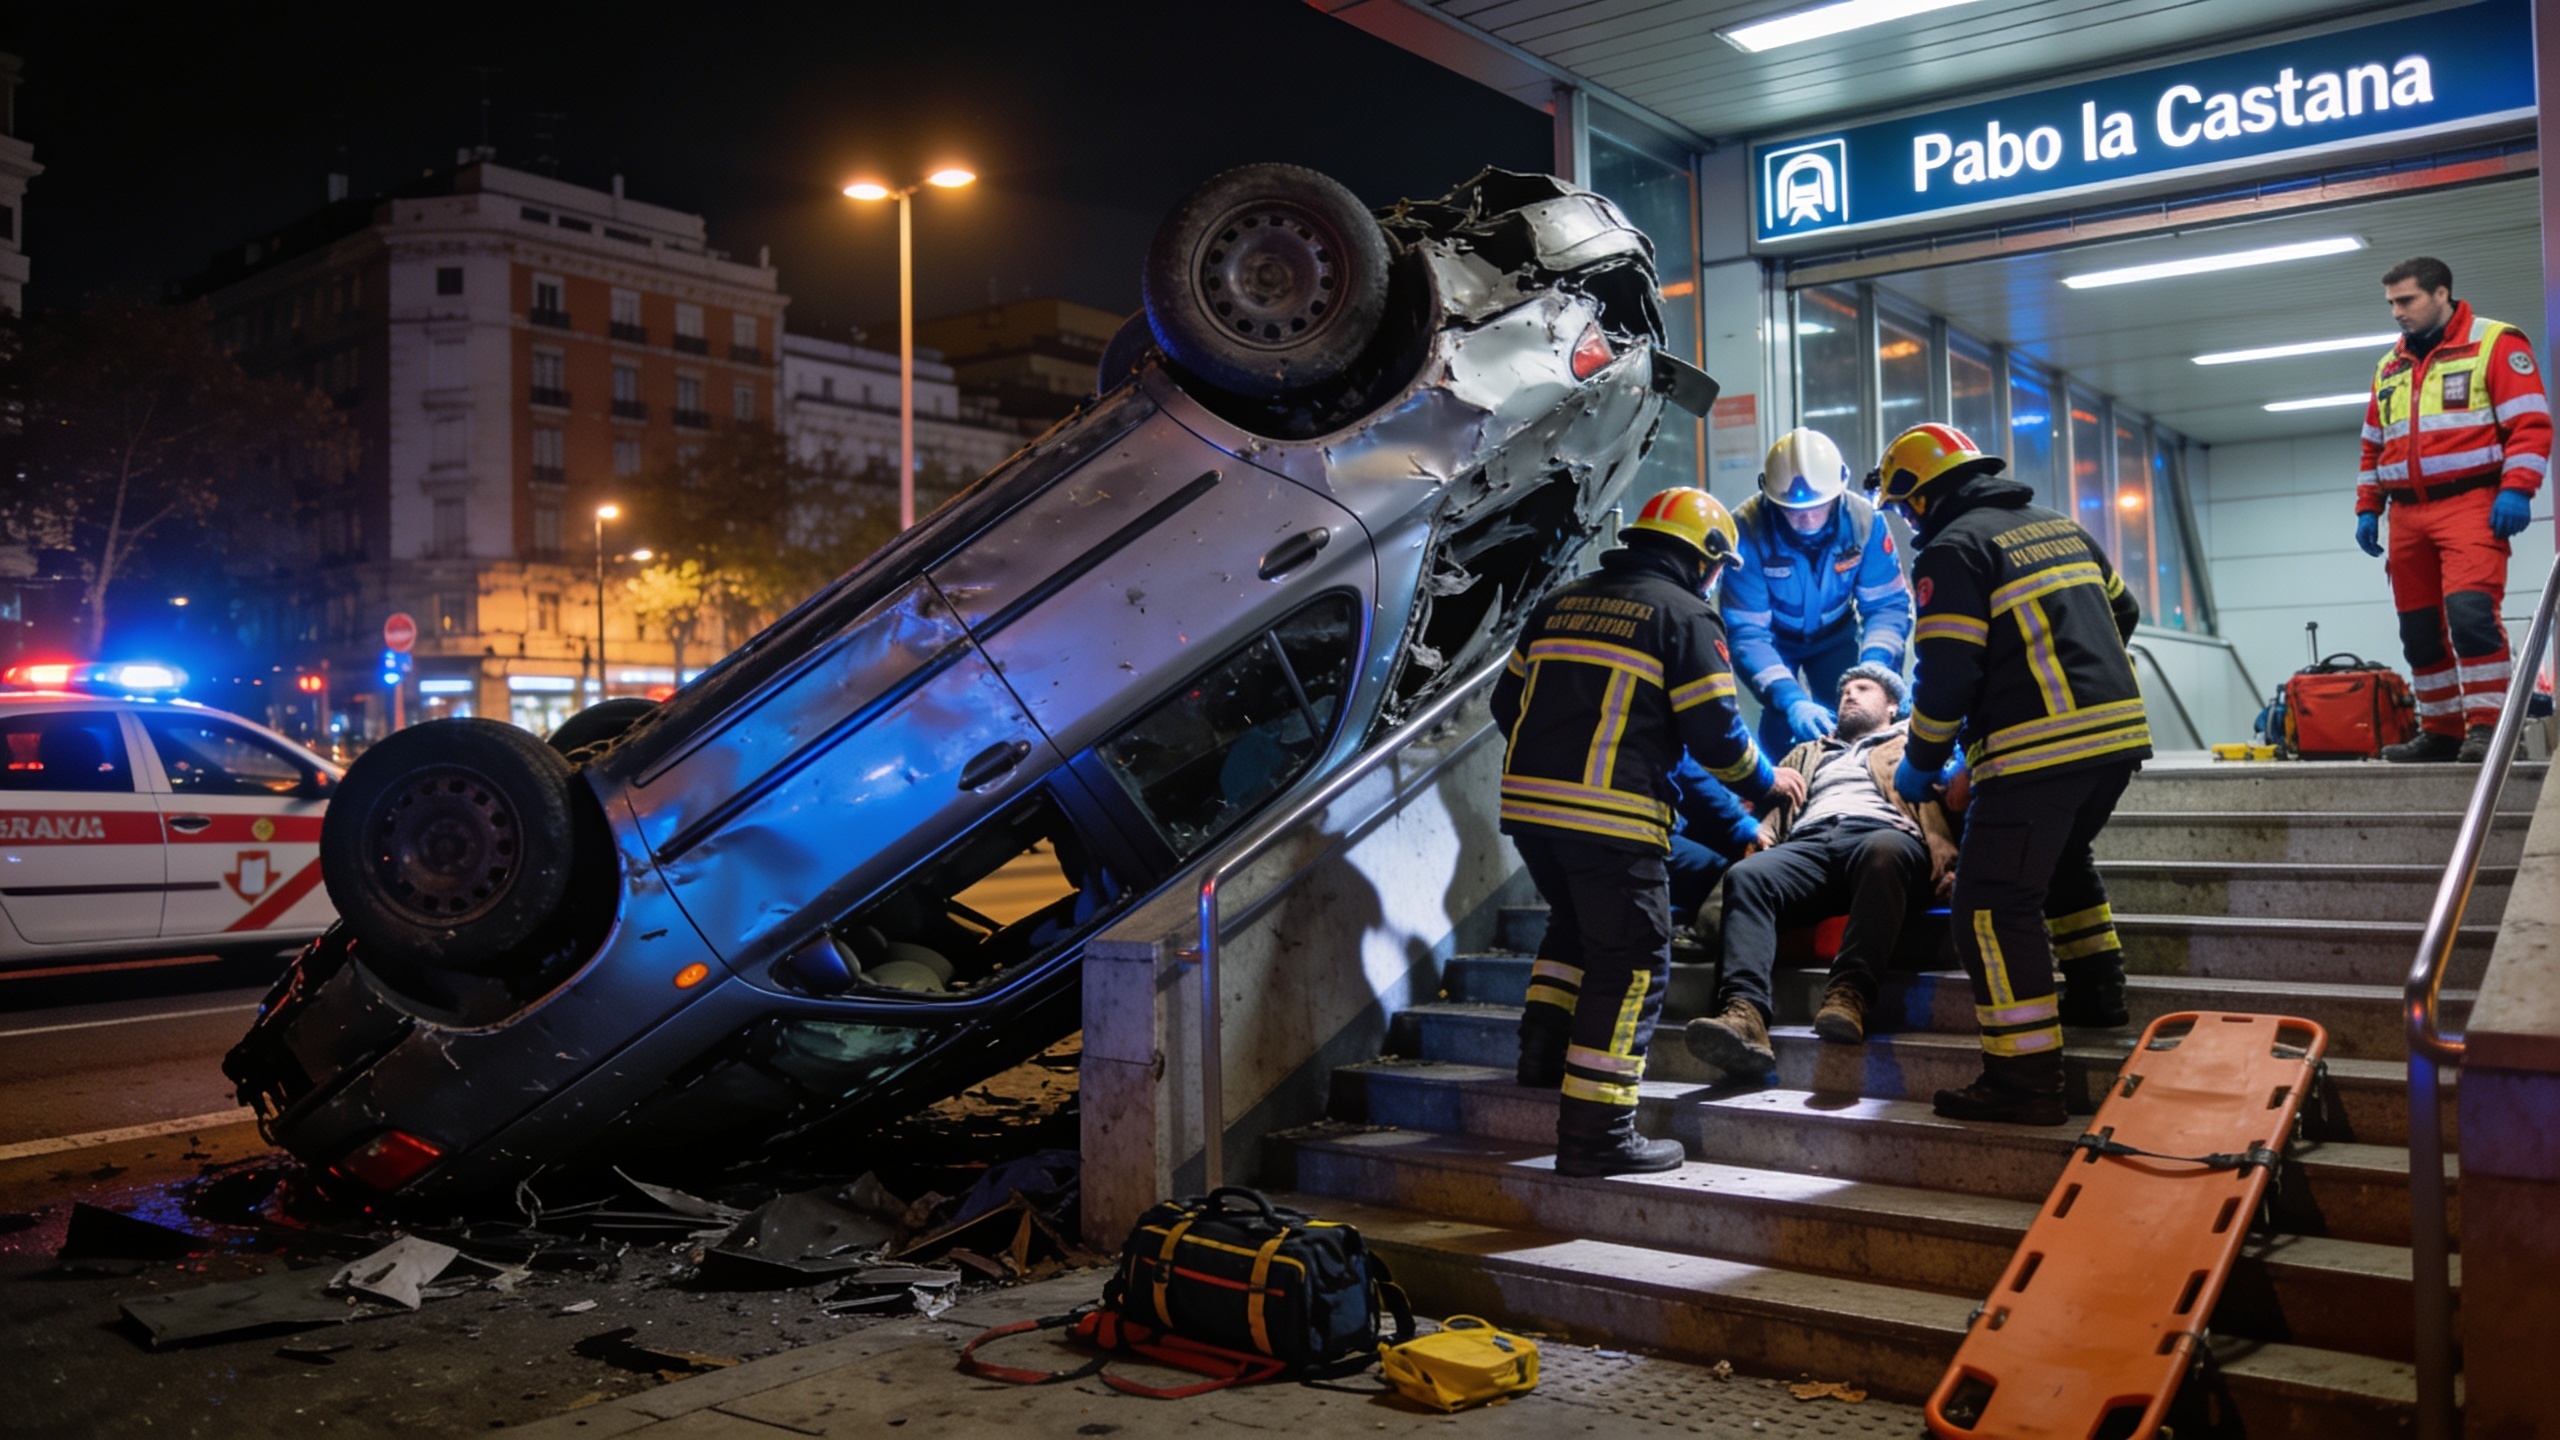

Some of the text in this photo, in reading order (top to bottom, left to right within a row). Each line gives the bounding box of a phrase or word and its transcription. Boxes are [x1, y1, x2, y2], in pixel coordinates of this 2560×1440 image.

[1914, 54, 2434, 192] Pabo la Castana
